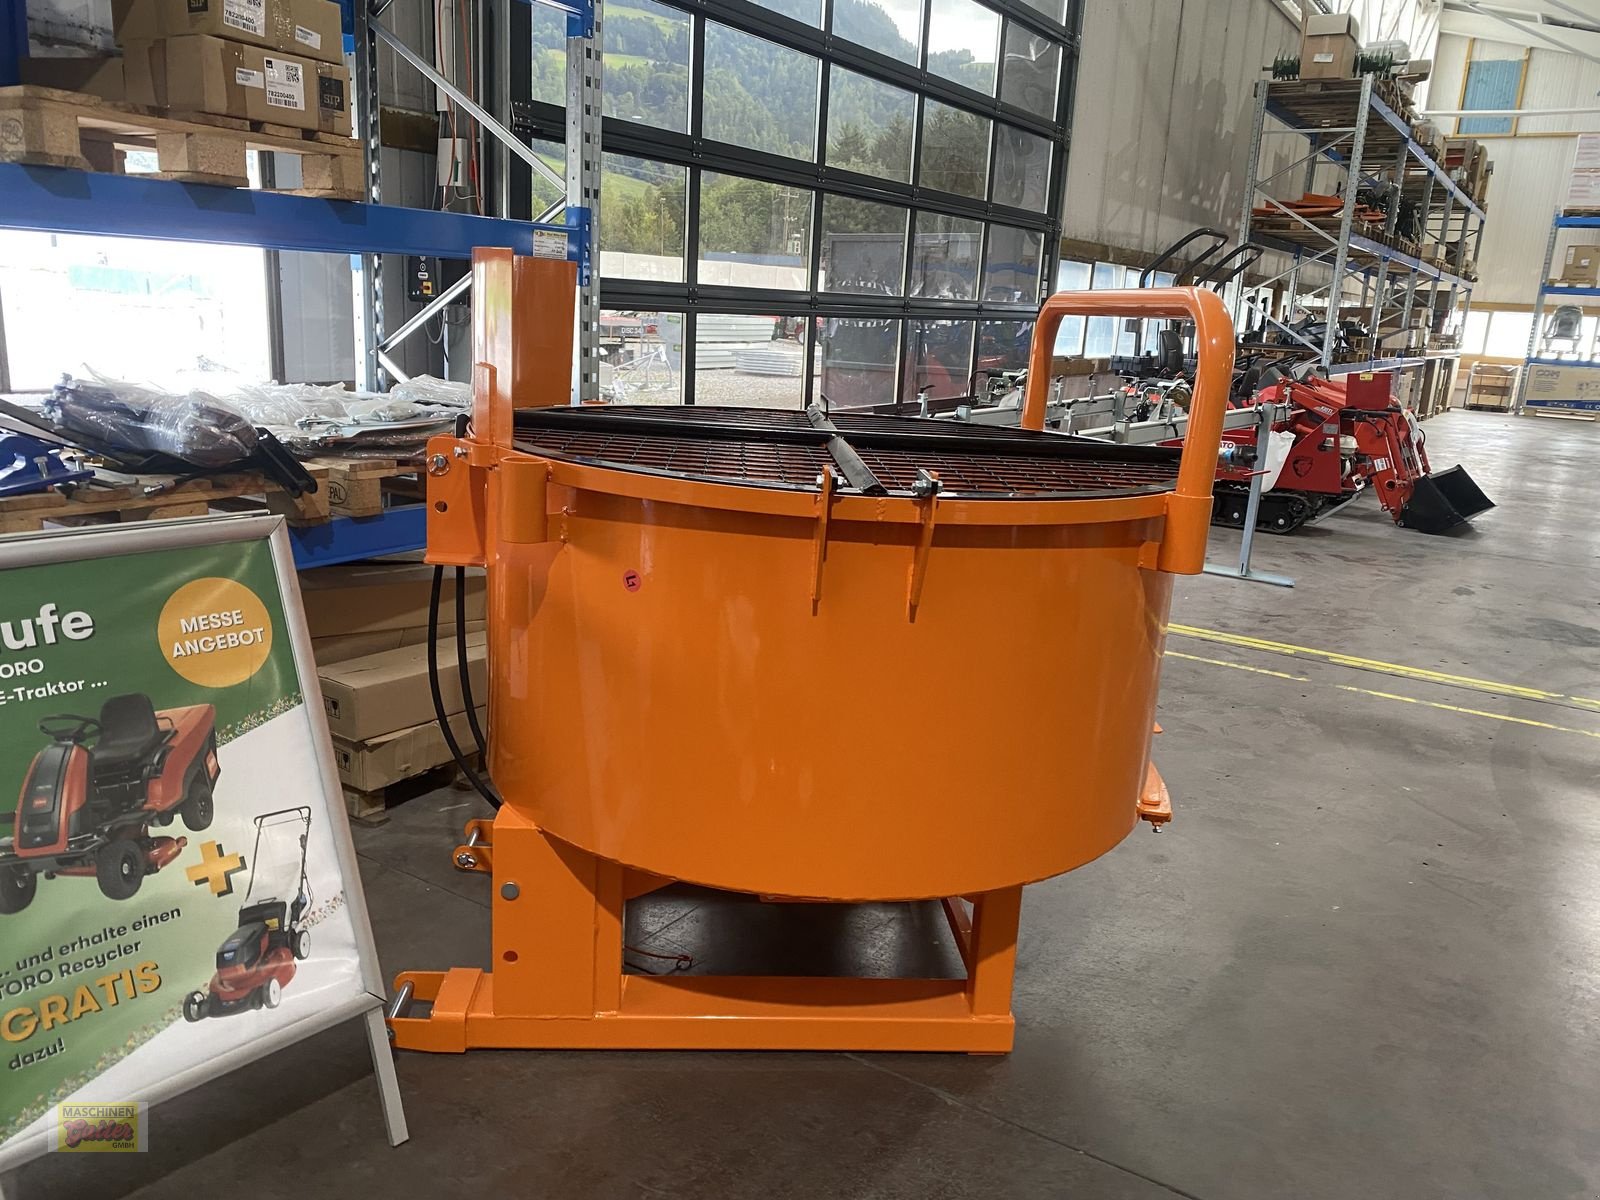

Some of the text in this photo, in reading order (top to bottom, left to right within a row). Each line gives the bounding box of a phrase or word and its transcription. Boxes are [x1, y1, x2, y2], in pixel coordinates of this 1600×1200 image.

[268, 90, 295, 100] 782200400
[1220, 442, 1234, 450] TO
[180, 610, 244, 634] MESSE
[172, 627, 264, 658] ANGEBOT
[16, 946, 54, 971] und
[59, 925, 127, 957] erhalte
[132, 908, 181, 932] einen
[58, 941, 141, 978] Recycler
[0, 960, 162, 1042] GRATIS
[8, 1038, 65, 1070] dazu!
